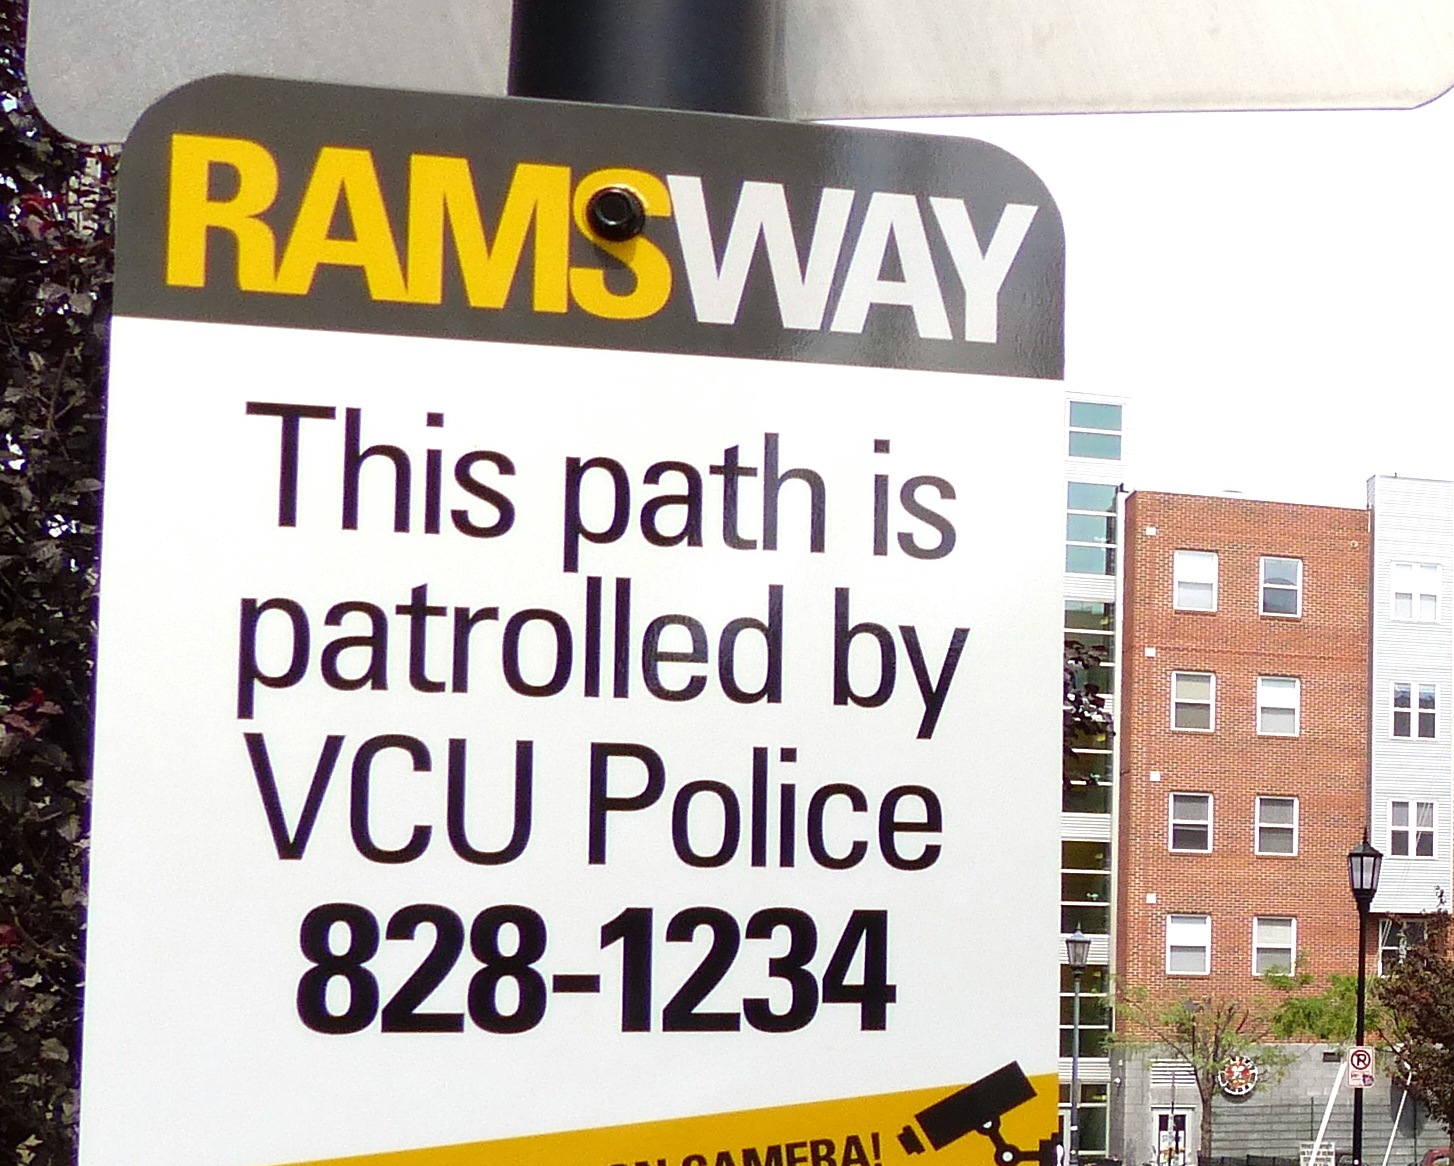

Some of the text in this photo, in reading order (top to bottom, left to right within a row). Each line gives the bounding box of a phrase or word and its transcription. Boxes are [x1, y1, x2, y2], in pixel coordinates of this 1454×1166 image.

[246, 401, 958, 573] This path is
[237, 576, 970, 740] patrolled by
[244, 732, 943, 871] VCU Police
[296, 902, 897, 1035] 828-1234
